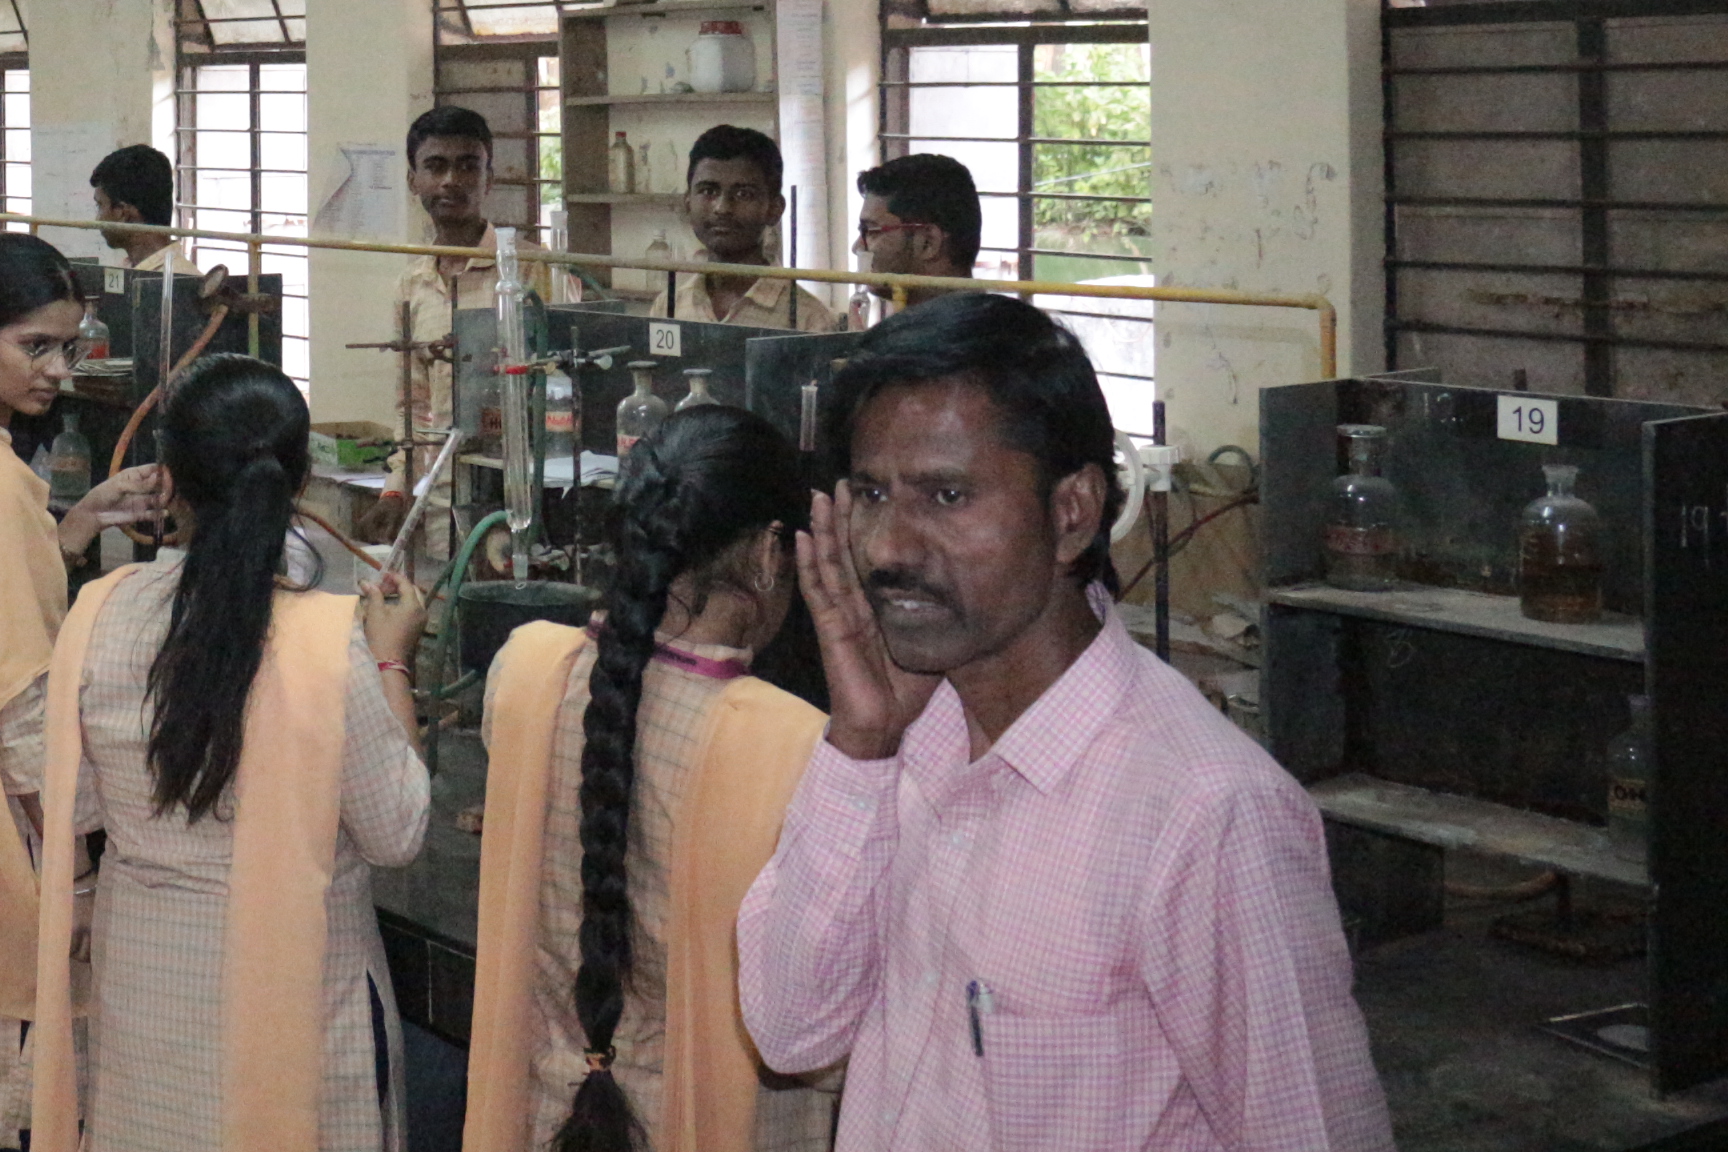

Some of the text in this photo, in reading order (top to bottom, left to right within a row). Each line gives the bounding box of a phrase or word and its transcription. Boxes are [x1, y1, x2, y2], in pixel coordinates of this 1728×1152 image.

[108, 272, 119, 288] 21
[656, 329, 675, 350] 20
[1512, 405, 1545, 435] 19
